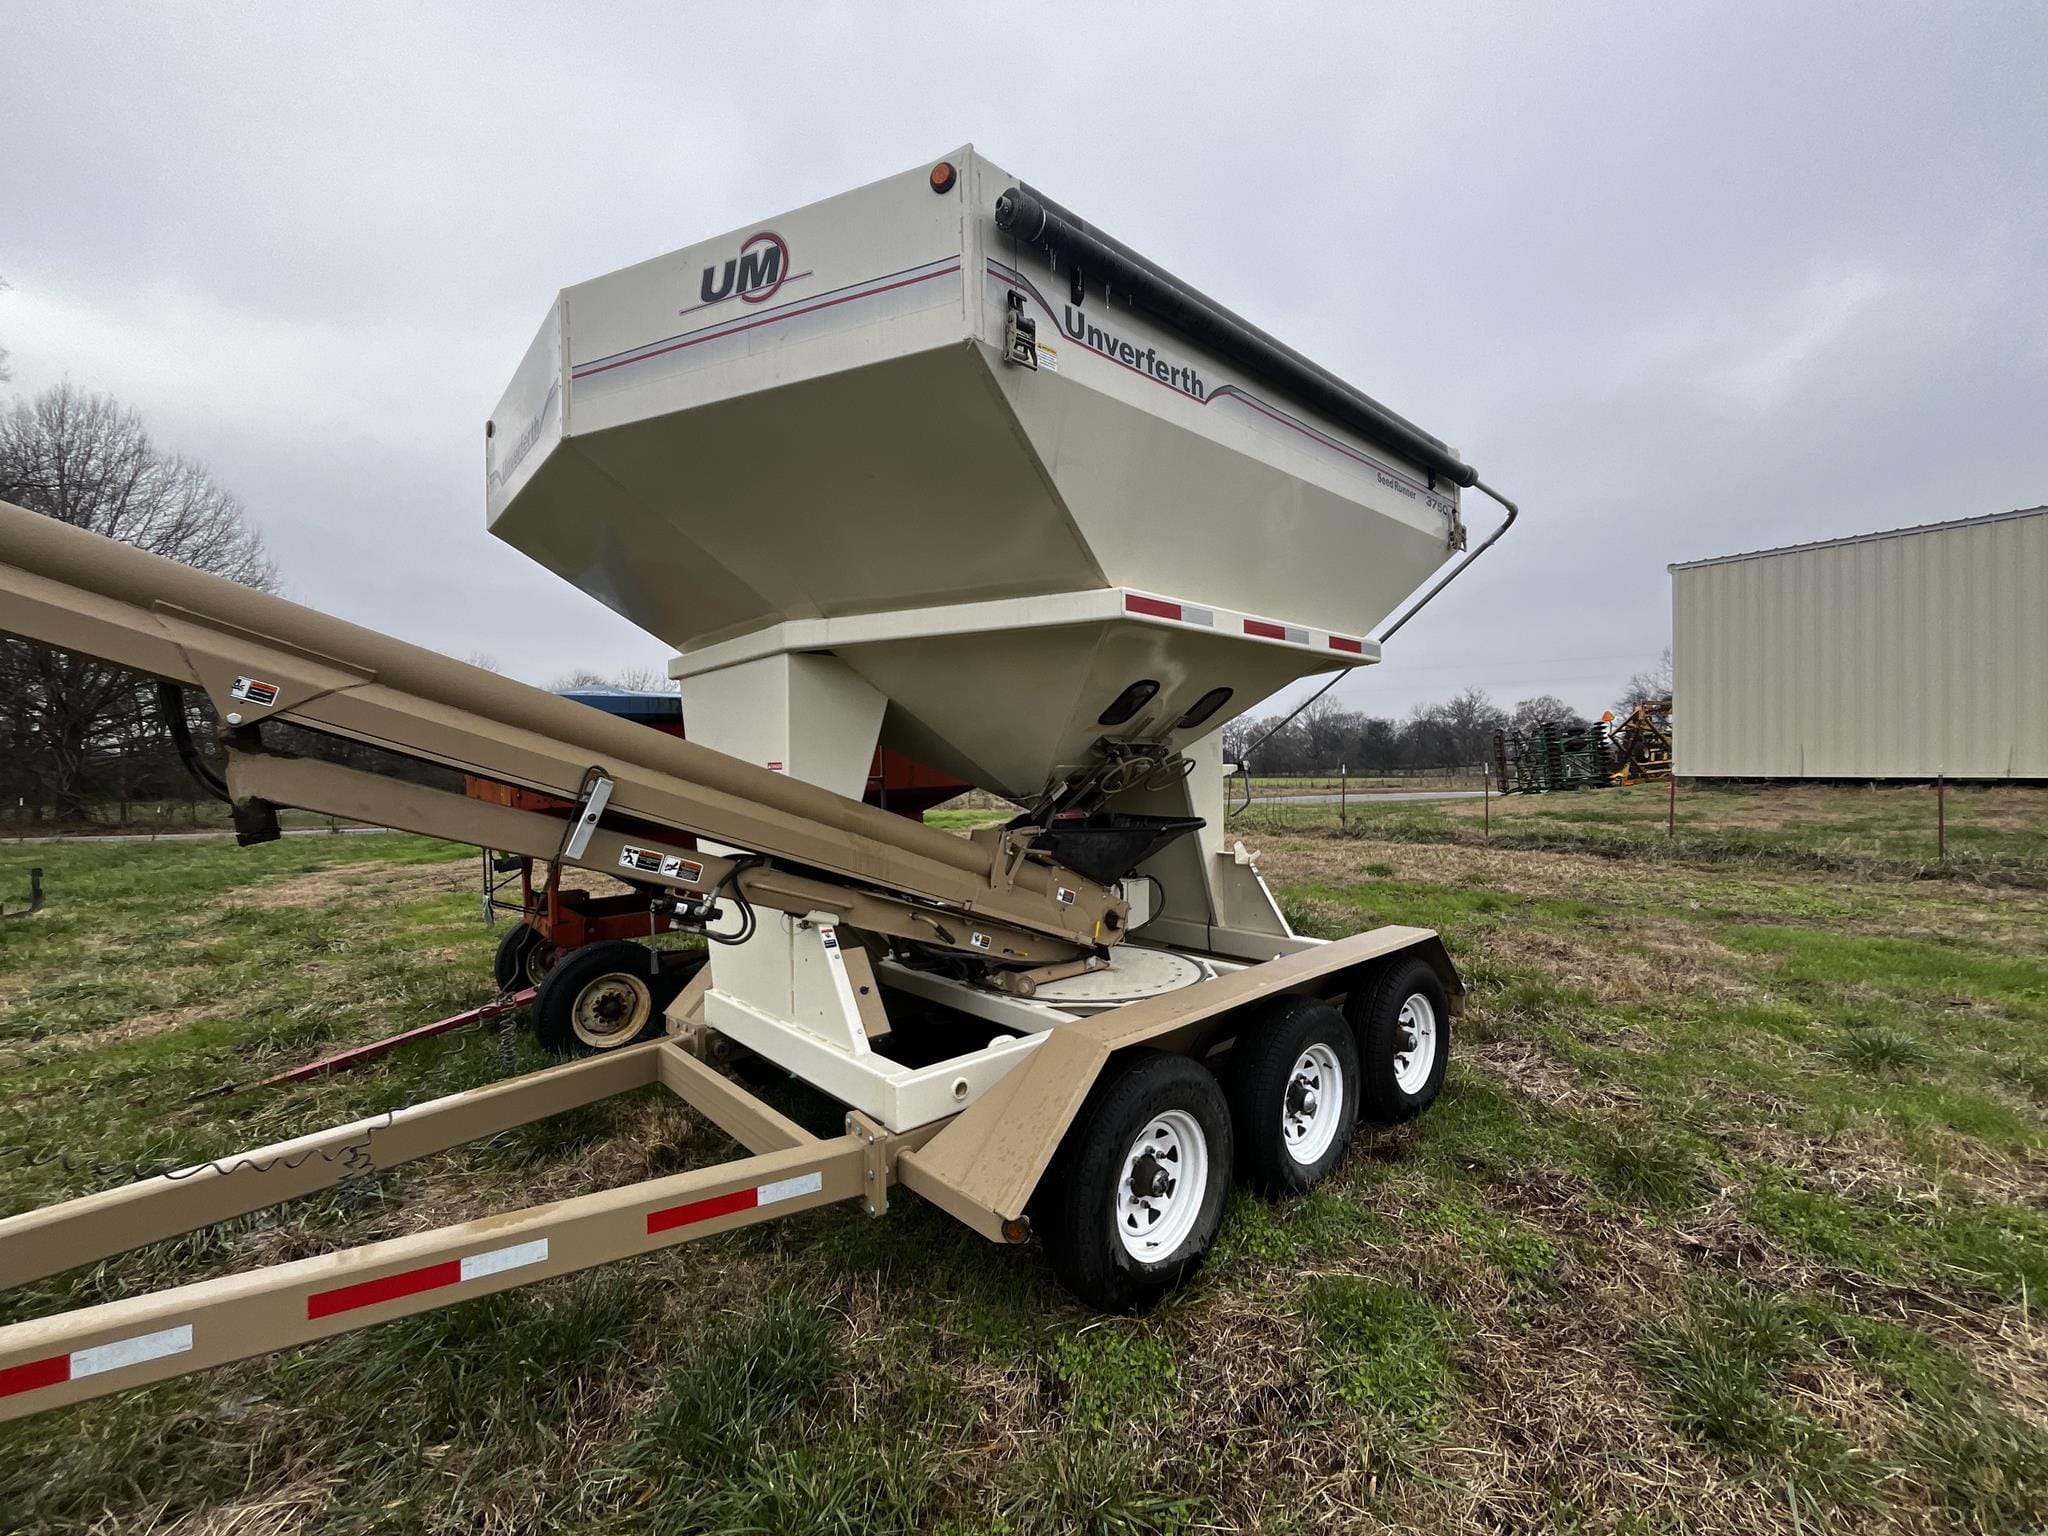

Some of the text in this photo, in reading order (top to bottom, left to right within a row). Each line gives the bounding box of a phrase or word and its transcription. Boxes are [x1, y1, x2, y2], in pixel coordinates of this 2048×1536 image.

[701, 245, 781, 302] UM
[1065, 304, 1204, 399] Unverferth
[1377, 471, 1416, 500] Seed Runner
